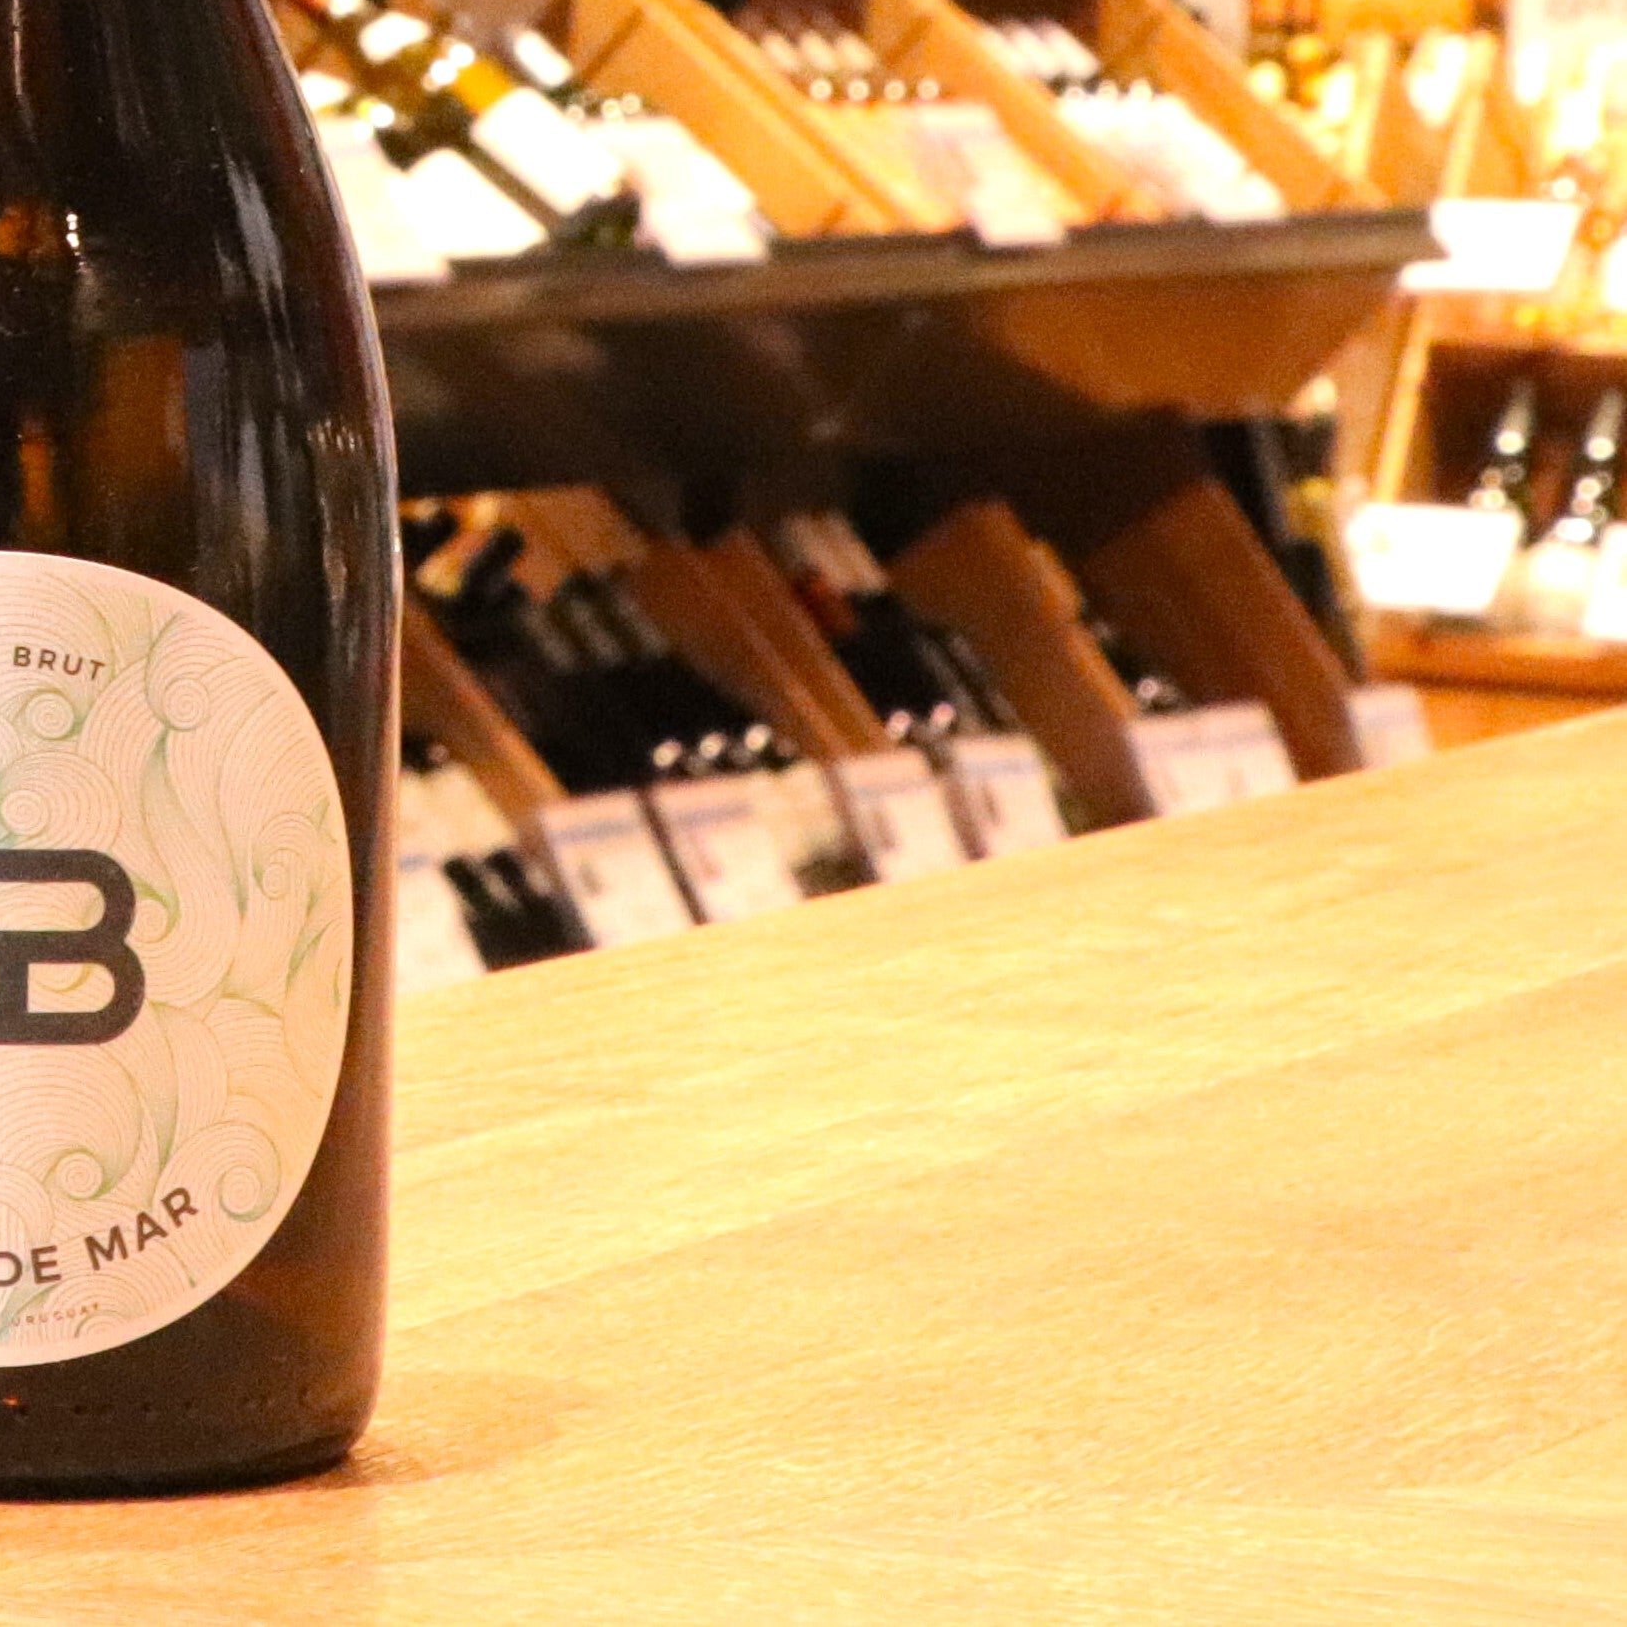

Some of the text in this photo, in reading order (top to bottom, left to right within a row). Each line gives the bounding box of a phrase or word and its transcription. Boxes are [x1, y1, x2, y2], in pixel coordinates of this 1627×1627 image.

[12, 645, 105, 680] BRUT
[84, 1186, 199, 1272] MAR
[12, 1301, 100, 1327] URUGUAY
